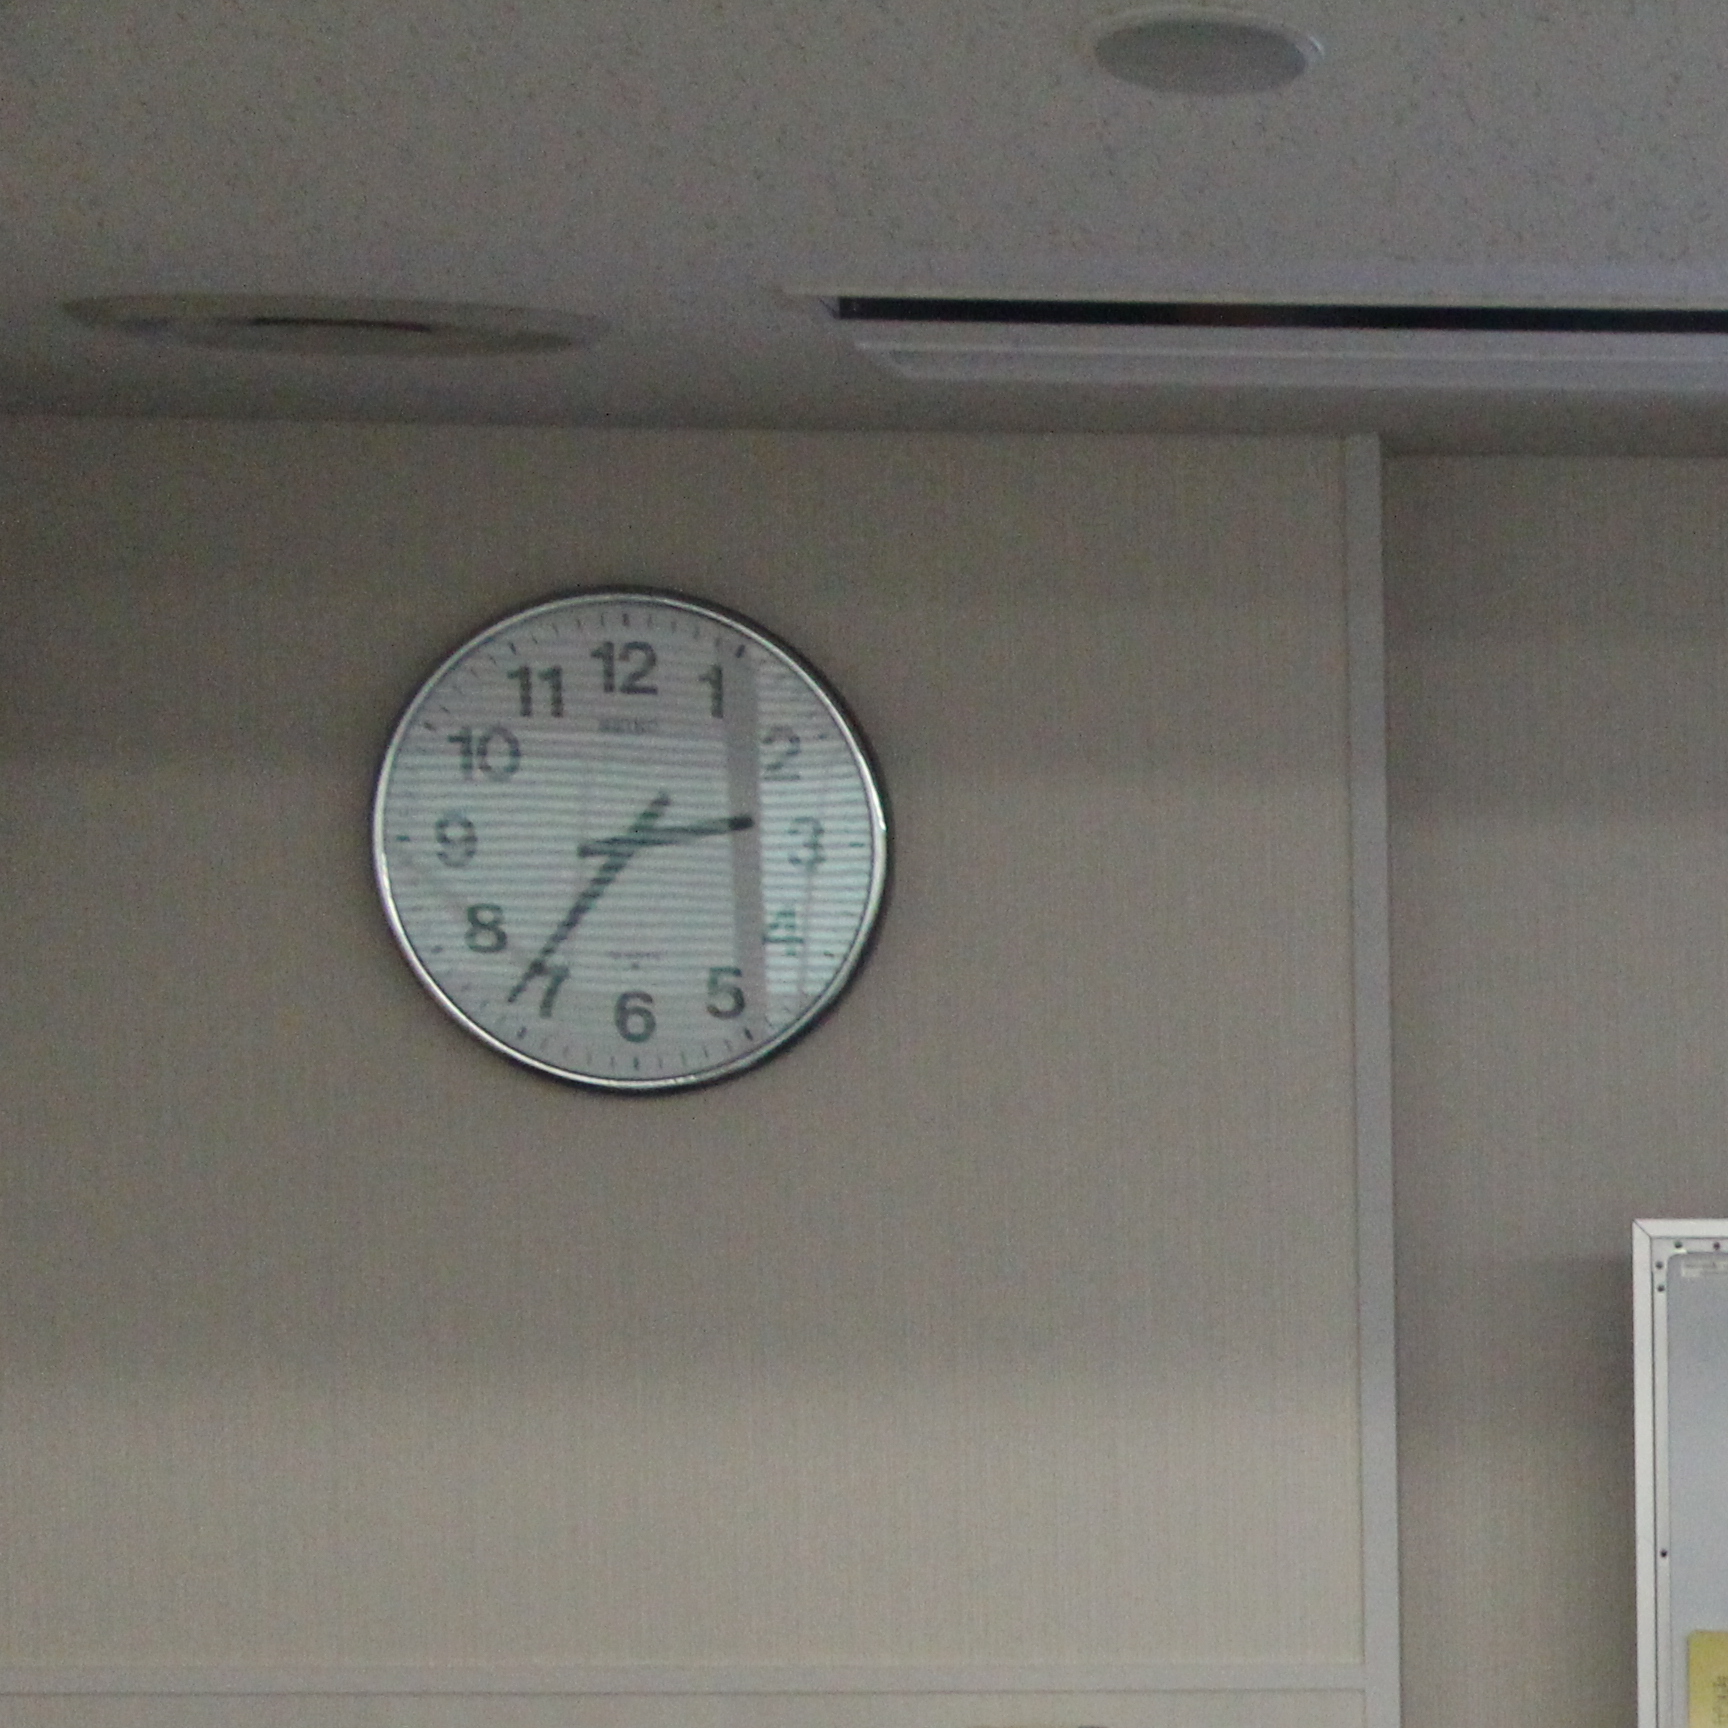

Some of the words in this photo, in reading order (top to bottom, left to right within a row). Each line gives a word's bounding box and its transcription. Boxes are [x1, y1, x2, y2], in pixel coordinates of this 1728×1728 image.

[507, 664, 565, 718] 11
[590, 641, 658, 695] 12
[699, 664, 724, 718] 1
[447, 726, 521, 782] 10
[762, 726, 802, 781] 2
[434, 811, 478, 868] 9
[787, 816, 827, 869] 3
[463, 902, 508, 954] 8
[761, 908, 804, 956] 4
[530, 962, 571, 1018] 7
[613, 990, 658, 1043] 6
[705, 966, 747, 1020] 5
